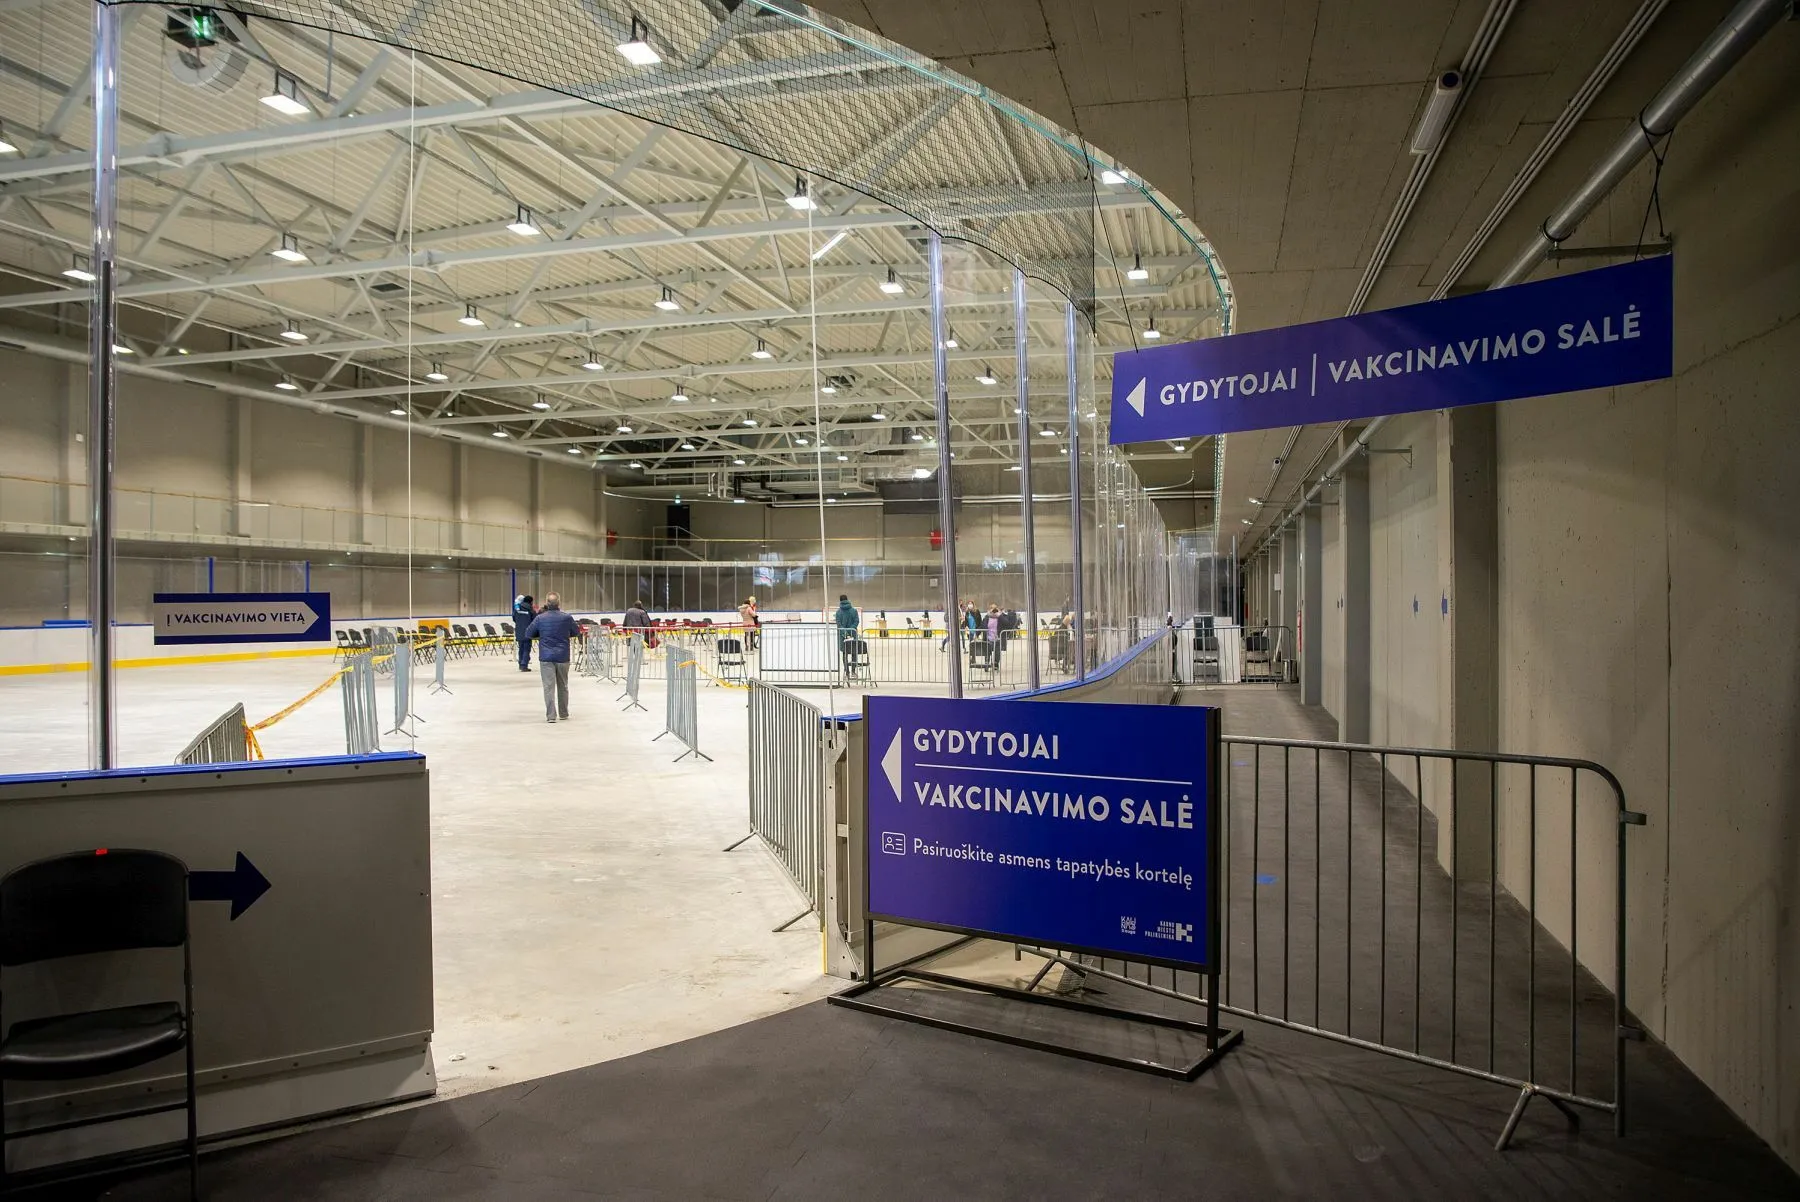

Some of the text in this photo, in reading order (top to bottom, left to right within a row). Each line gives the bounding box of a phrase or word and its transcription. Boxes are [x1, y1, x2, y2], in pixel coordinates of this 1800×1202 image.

[1160, 304, 1643, 410] GYDYTOJAI VAKCINAVIMO SALĖ
[166, 612, 306, 628] Į VAKCINAVIMO VIETĄ
[913, 728, 1060, 760] GYDYTOJAI
[913, 781, 1194, 830] VAKCINAVIMO SALĖ
[913, 837, 1194, 891] Pasiruoškite asmens tapatybės kortelę
